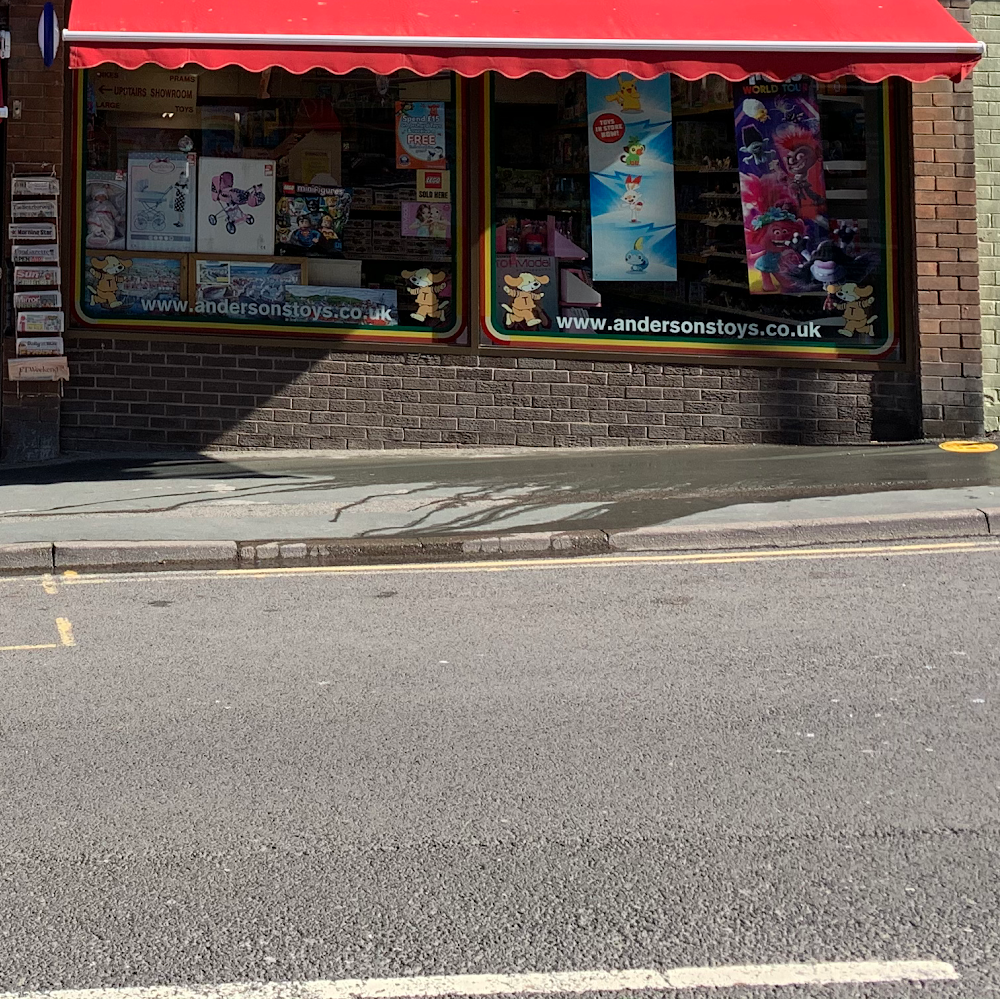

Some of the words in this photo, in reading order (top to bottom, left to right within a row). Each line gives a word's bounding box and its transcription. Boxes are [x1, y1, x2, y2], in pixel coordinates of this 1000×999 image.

[151, 88, 193, 99] SHOWROOM
[743, 85, 779, 94] WORLD
[407, 135, 436, 145] FREE
[434, 191, 449, 199] HERE
[17, 270, 40, 279] Sun
[141, 299, 392, 321] www.andersonstoys.co.uk
[556, 315, 822, 339] www.andersonstoys.co.uk
